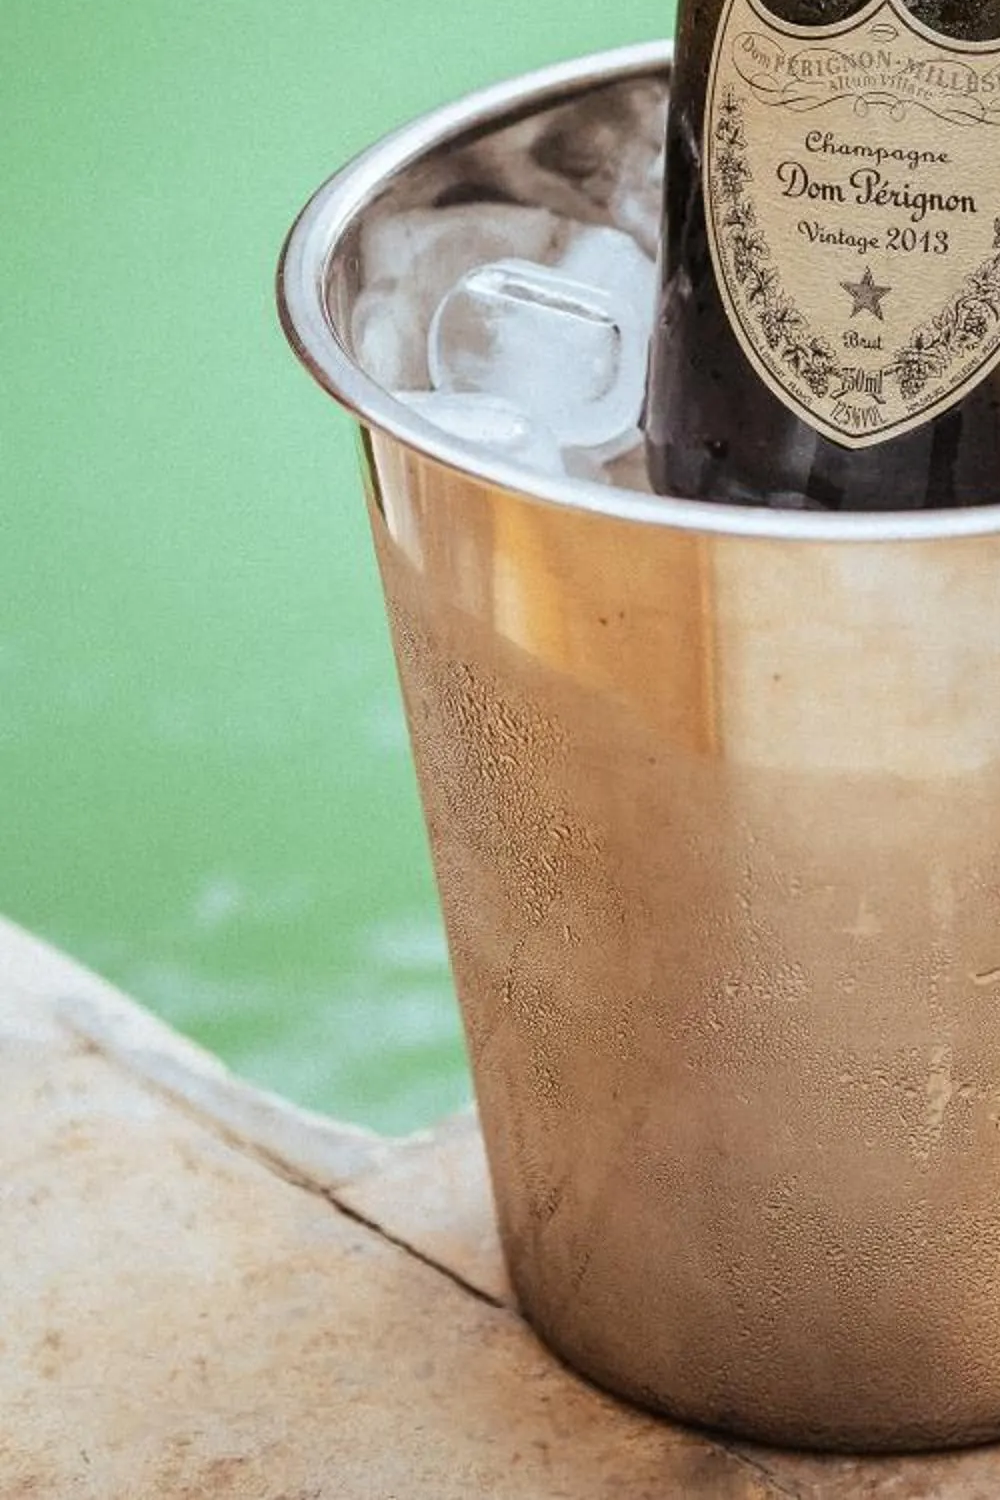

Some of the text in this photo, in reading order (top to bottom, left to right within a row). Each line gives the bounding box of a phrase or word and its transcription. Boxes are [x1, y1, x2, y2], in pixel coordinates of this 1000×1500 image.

[740, 34, 771, 69] Dom
[804, 129, 953, 170] Champagne
[776, 160, 978, 223] Dom Pérignon
[797, 220, 950, 255] Vintage 2013
[842, 330, 883, 350] Brut
